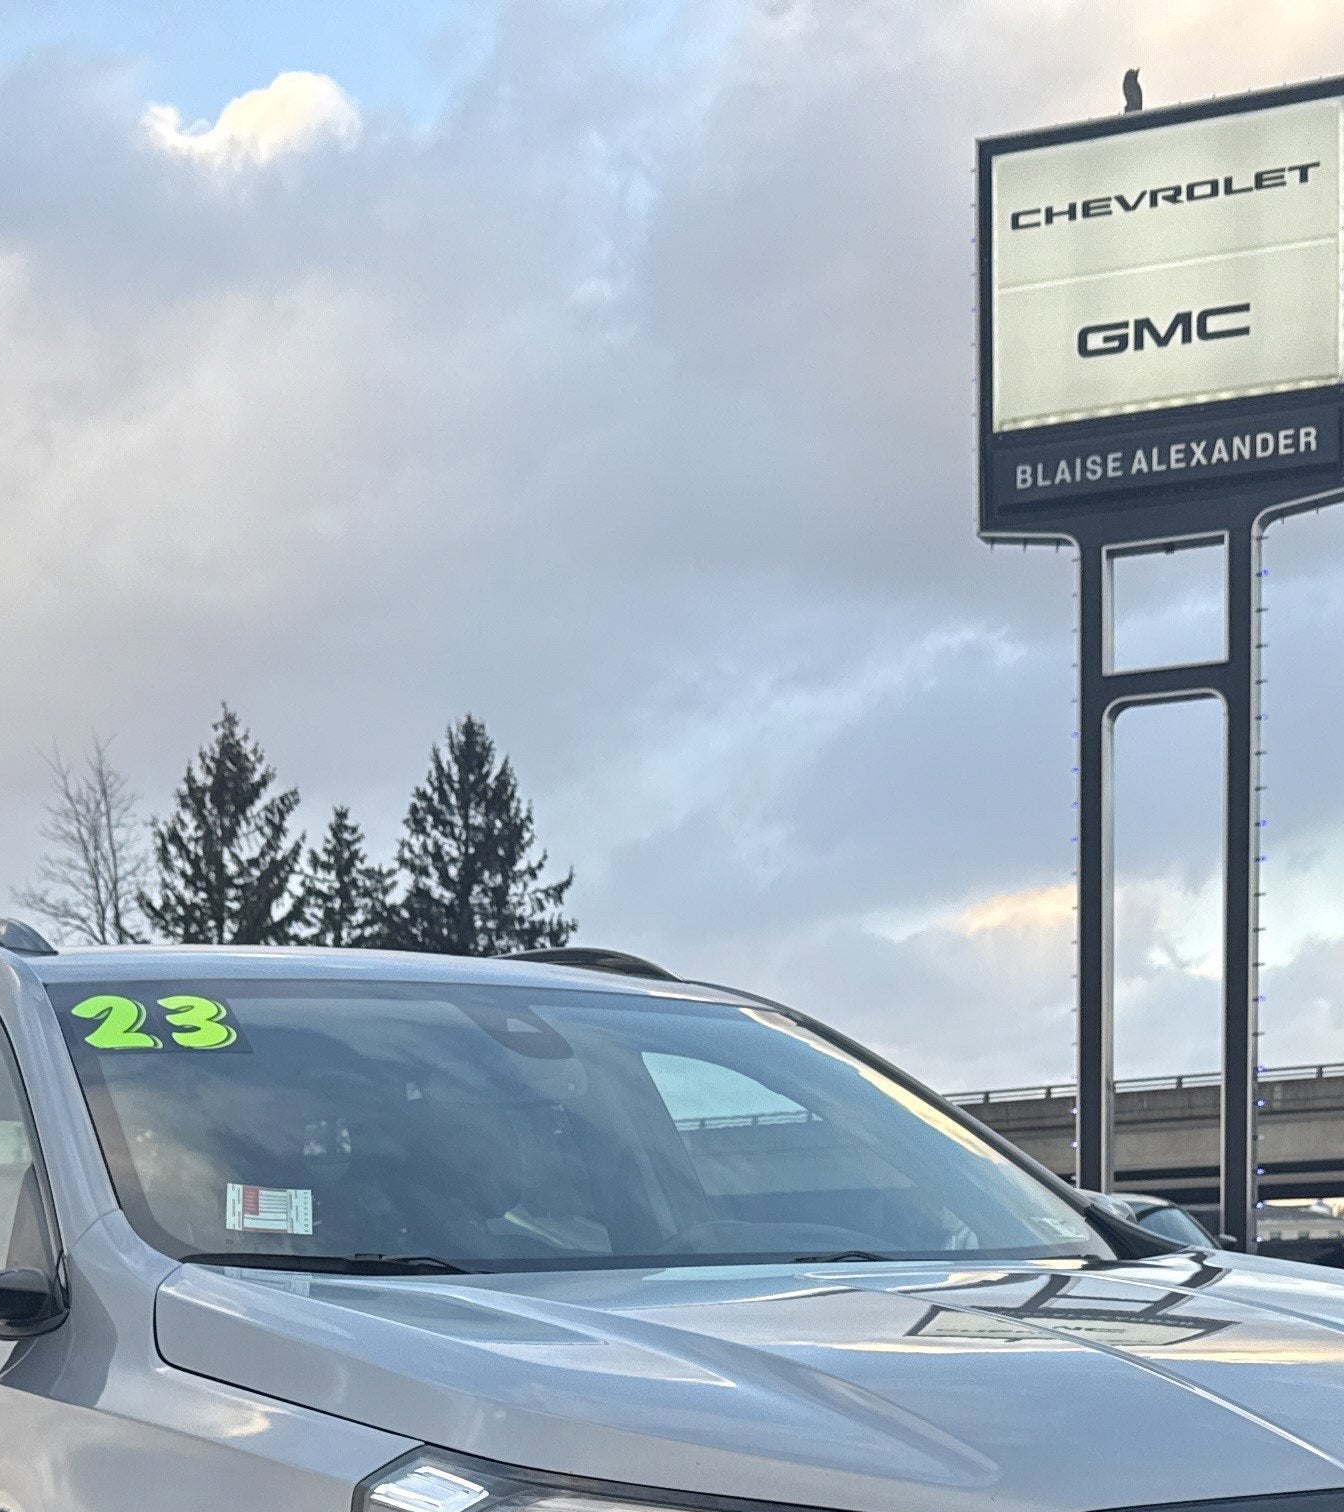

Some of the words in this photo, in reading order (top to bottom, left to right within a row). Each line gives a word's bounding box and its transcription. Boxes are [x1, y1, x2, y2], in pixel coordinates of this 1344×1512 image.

[1010, 161, 1321, 231] CHEVROLET
[1076, 302, 1251, 359] GMC
[1015, 452, 1123, 490] BLAISE
[1131, 426, 1318, 474] ALEXANDER
[71, 995, 237, 1049] 23
